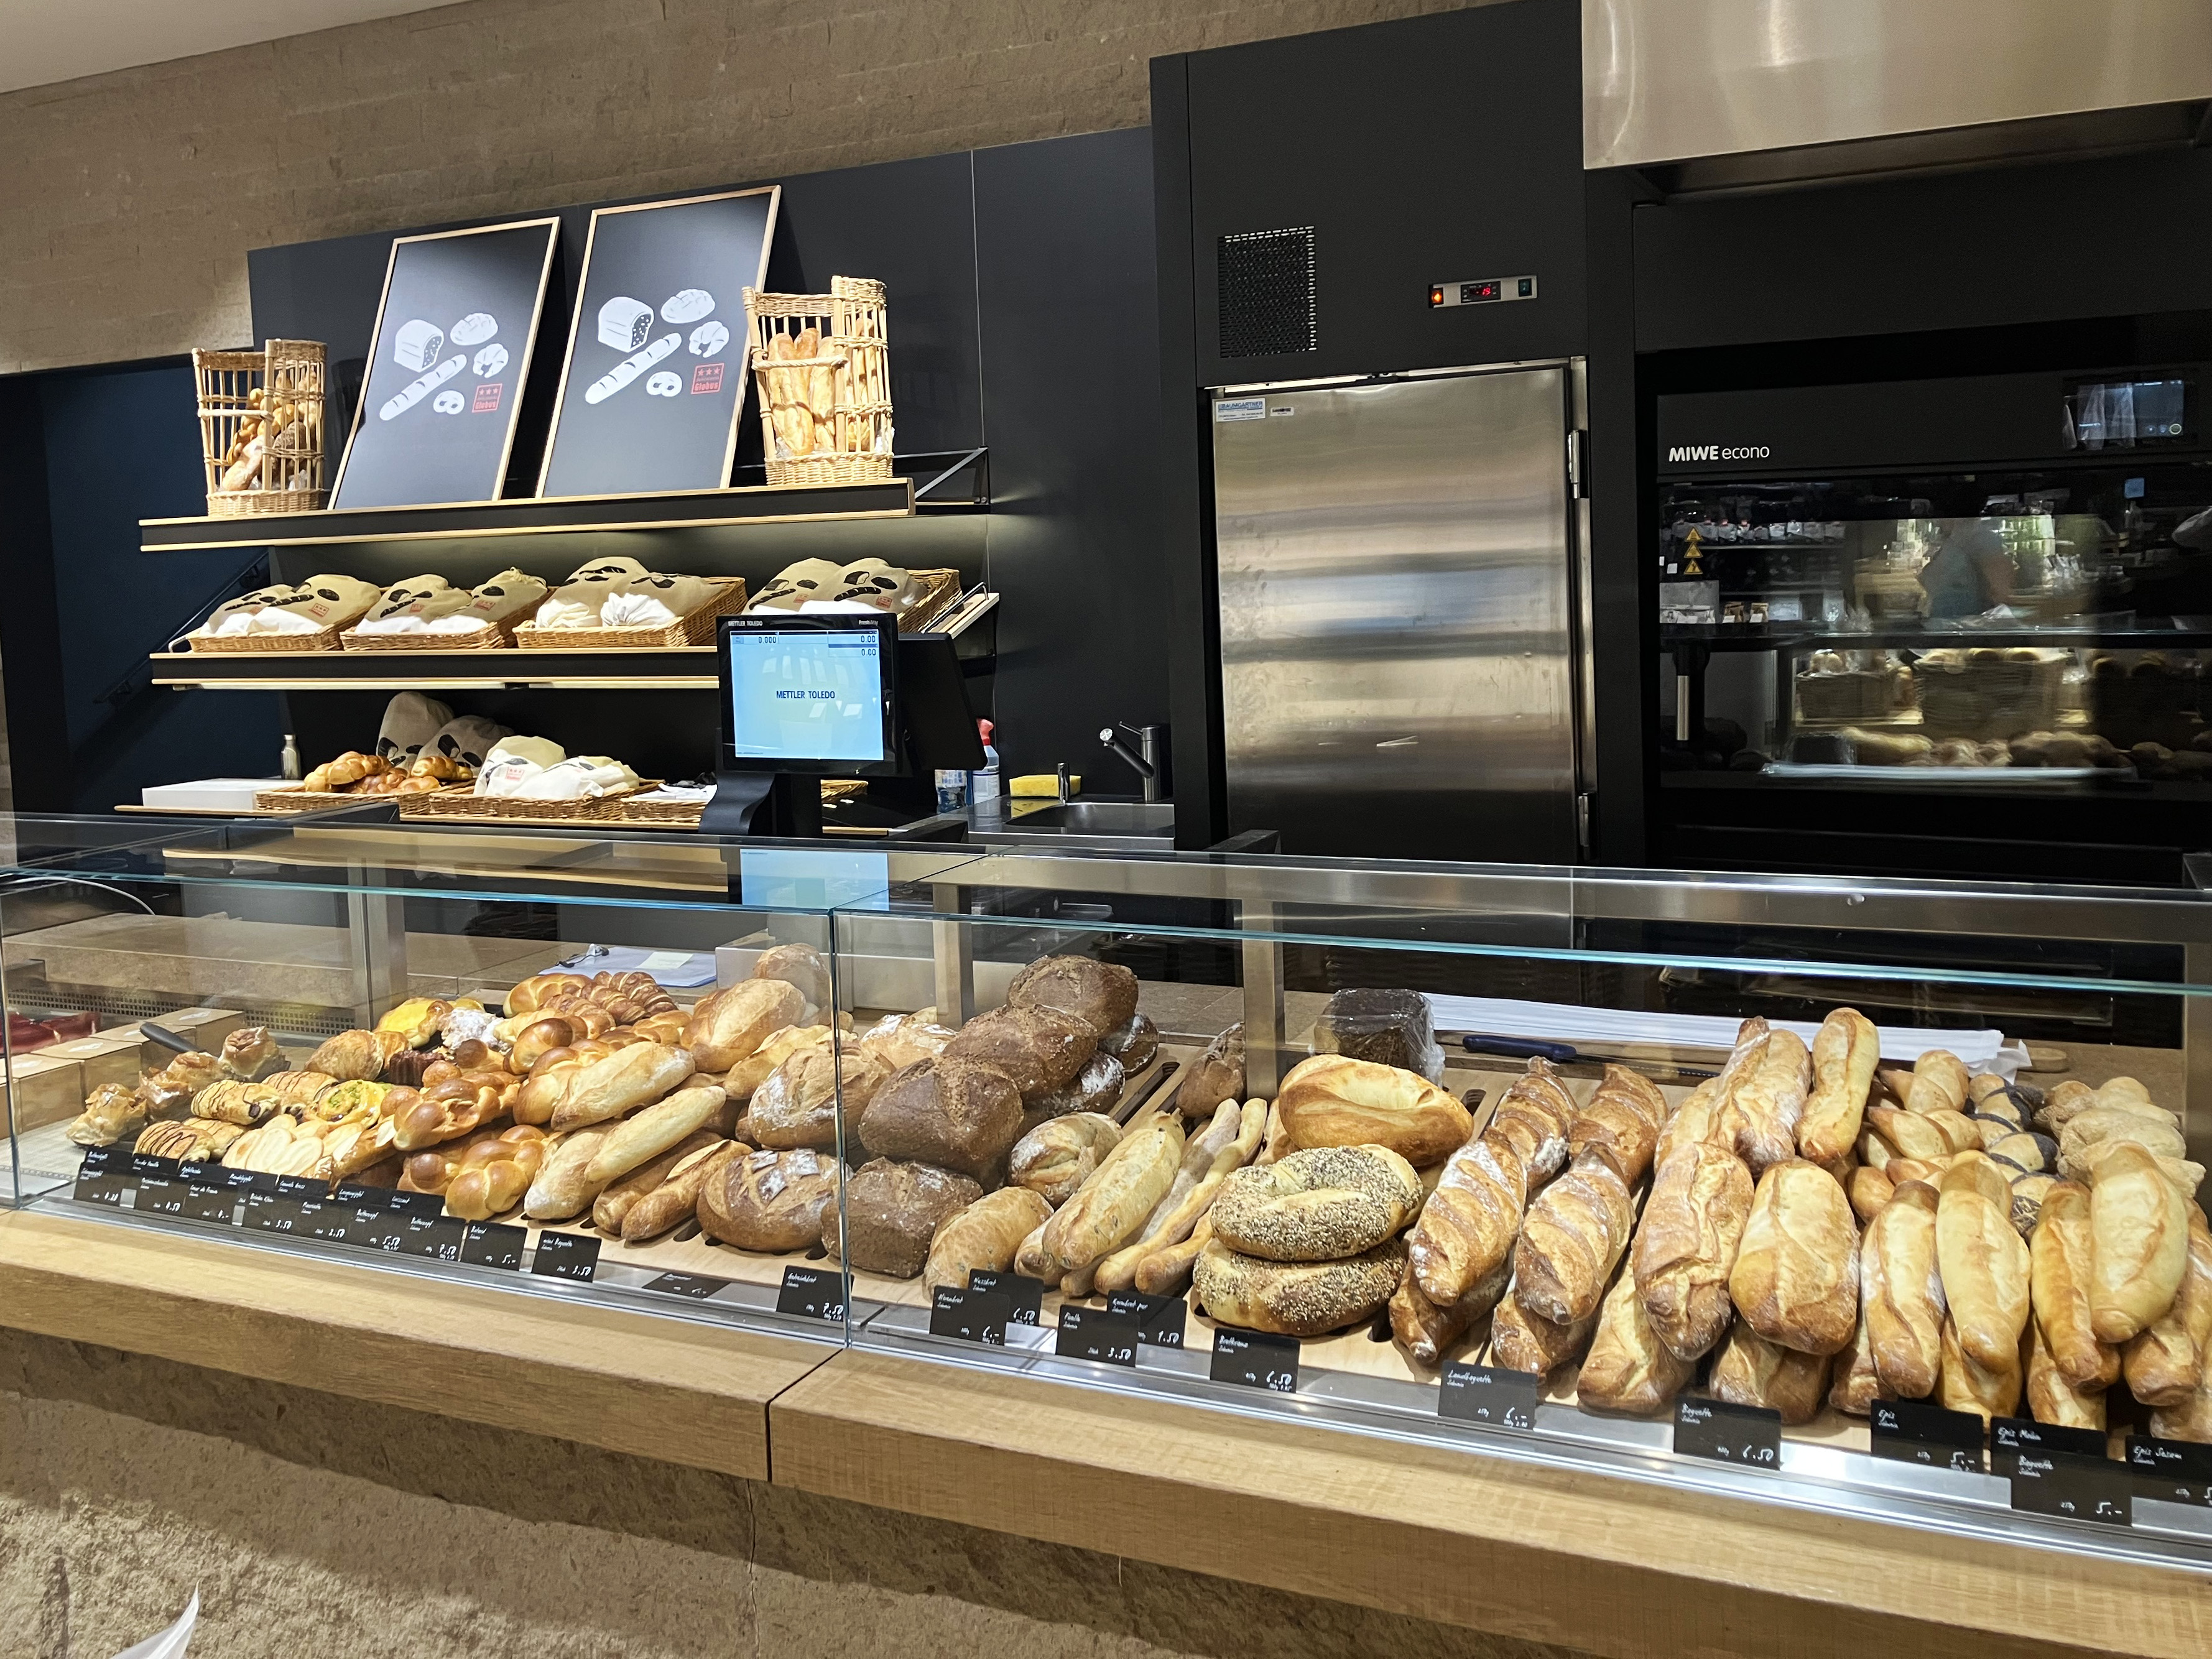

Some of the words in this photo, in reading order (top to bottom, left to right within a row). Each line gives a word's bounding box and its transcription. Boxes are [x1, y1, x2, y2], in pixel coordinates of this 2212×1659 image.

[694, 382, 720, 391] Globus
[474, 401, 497, 409] Globus
[1668, 445, 1719, 462] MIWE
[1722, 446, 1770, 460] econo
[861, 635, 876, 643] 0.00
[776, 690, 805, 699] METTLER
[808, 690, 835, 699] TOLEDO
[382, 1235, 402, 1246] 5.50
[572, 1264, 592, 1277] 3.50
[973, 1277, 997, 1288] Nussbrot
[822, 1302, 845, 1315] 7.50
[1012, 1306, 1037, 1322] 6.50
[1157, 1329, 1180, 1345] 1.50
[1107, 1346, 1132, 1361] 3.50
[1266, 1370, 1293, 1386] 6.50
[1681, 1403, 1713, 1418] Baguette
[1742, 1444, 1775, 1462] 6.50
[2095, 1501, 2123, 1517] 5.-
